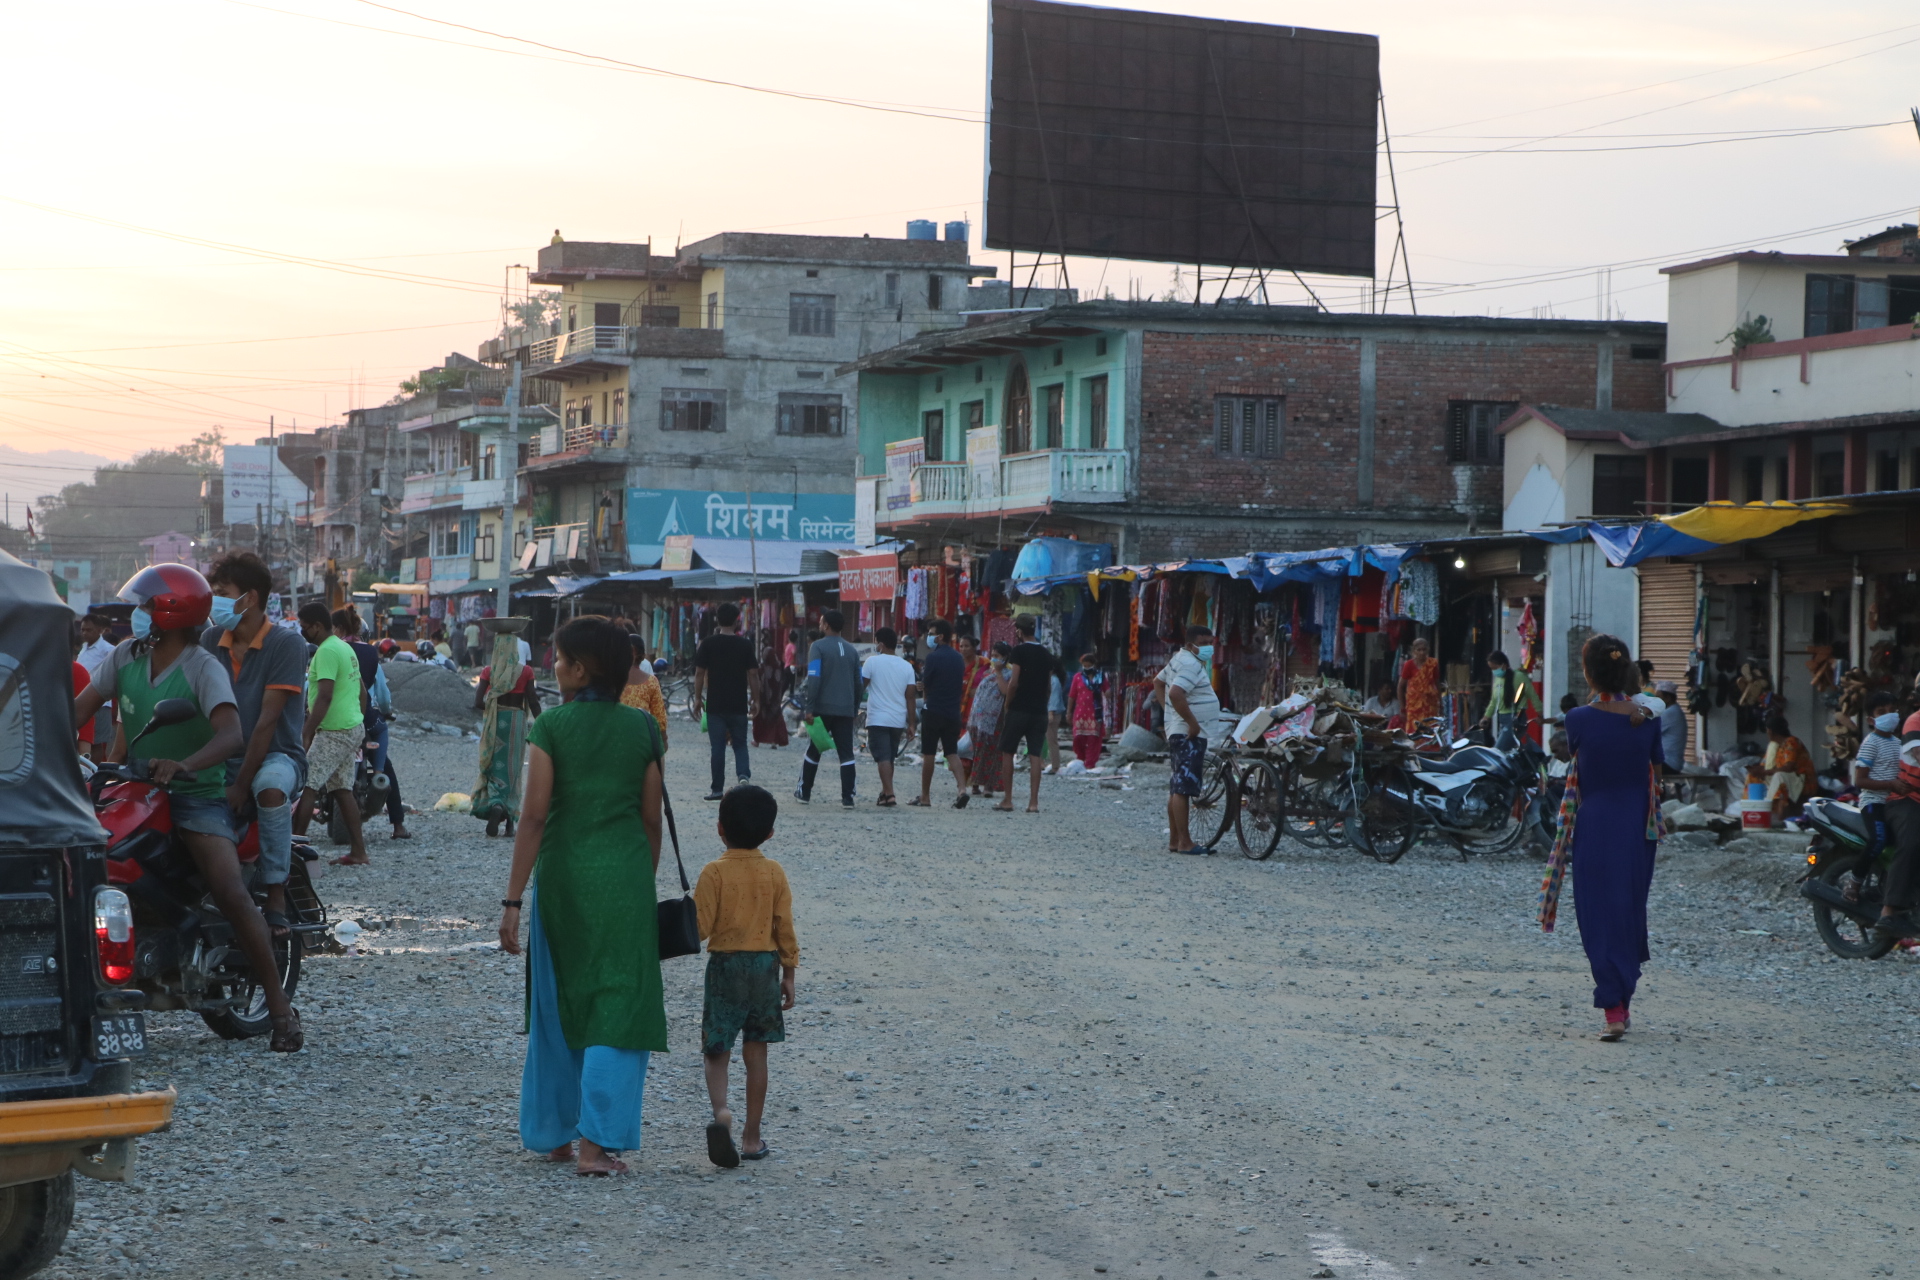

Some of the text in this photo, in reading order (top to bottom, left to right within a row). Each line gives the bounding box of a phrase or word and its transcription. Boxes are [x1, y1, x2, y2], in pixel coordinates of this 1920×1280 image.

[704, 493, 795, 540] शिवम्
[840, 561, 896, 598] होटल शुभकामना
